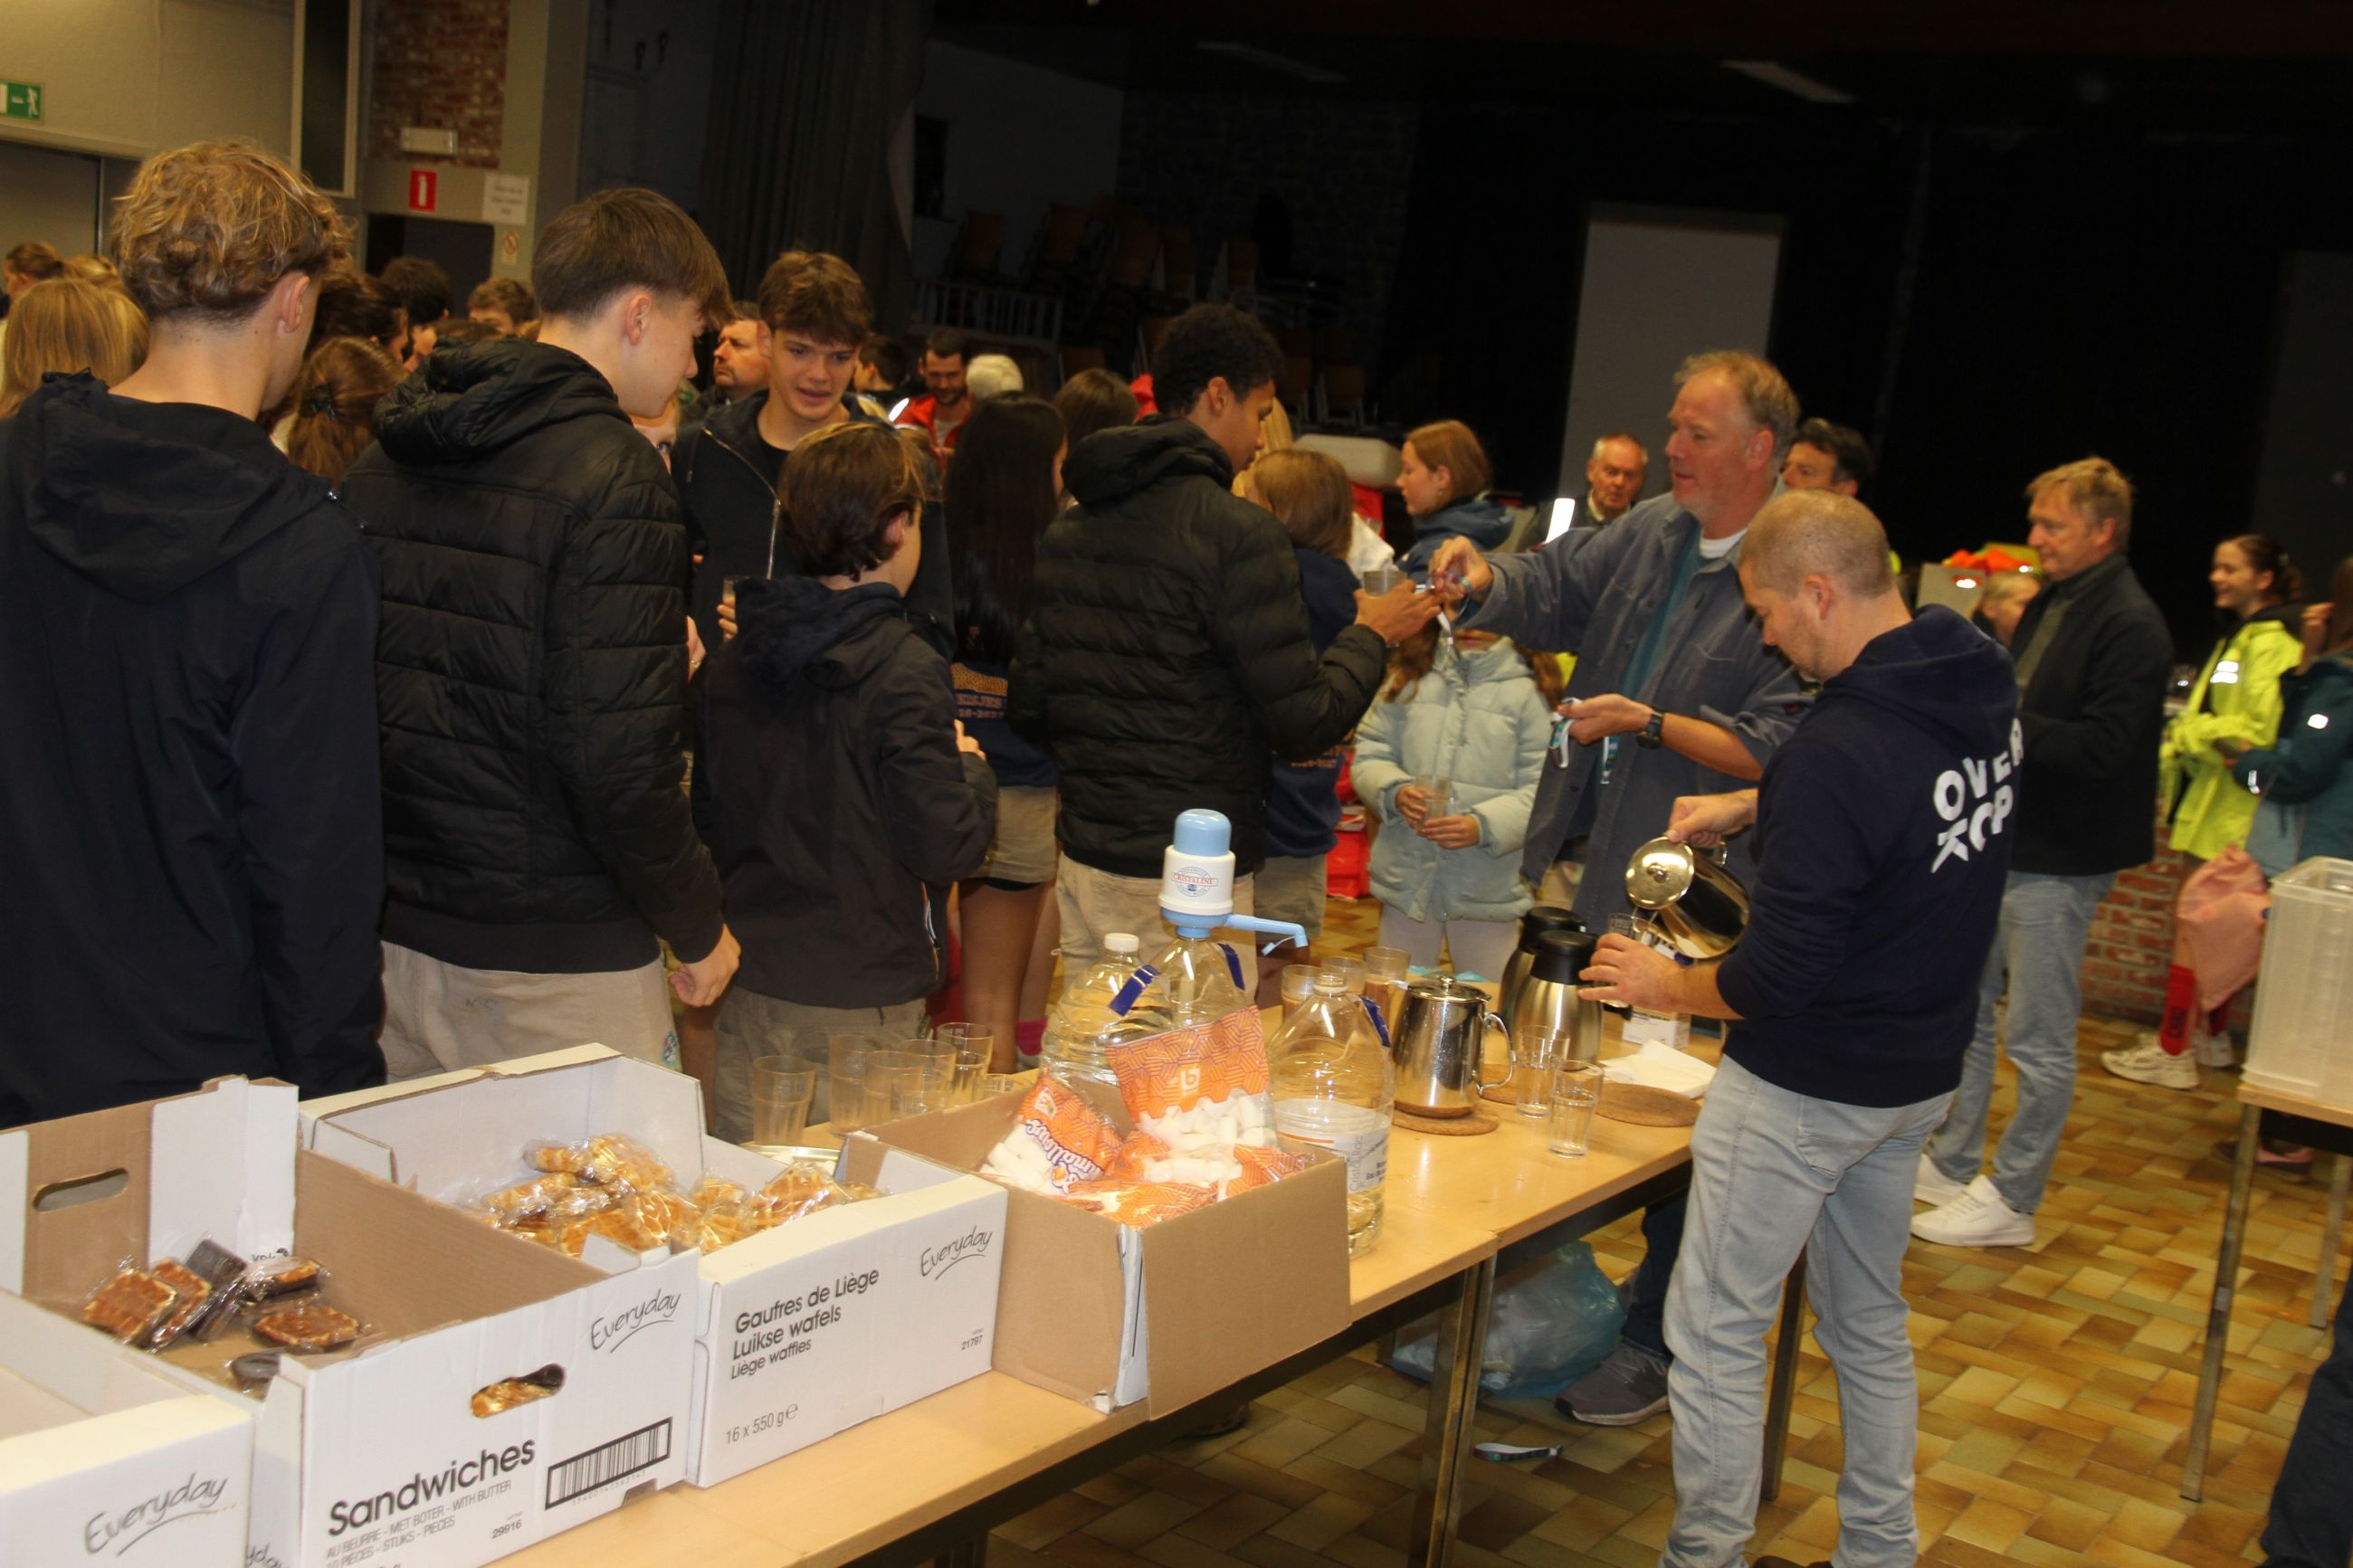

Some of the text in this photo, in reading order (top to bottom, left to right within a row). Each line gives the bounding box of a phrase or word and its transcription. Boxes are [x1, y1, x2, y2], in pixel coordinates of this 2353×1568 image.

[920, 1225, 994, 1278] Everyday
[591, 1288, 681, 1350] Everyday
[735, 1269, 880, 1334] Gaufres de Liège
[731, 1338, 812, 1380] Liège waffles
[732, 1305, 842, 1361] Luikse wafels
[961, 1335, 984, 1351] 21797
[725, 1425, 740, 1444] 16
[742, 1423, 750, 1438] x
[752, 1412, 775, 1435] 550
[84, 1472, 229, 1554] Everyday
[329, 1440, 536, 1536] Sandwiches
[327, 1479, 512, 1559] AU BEURRE MET BOTER WITH BUTTER
[383, 1532, 416, 1553] STUKS
[424, 1515, 456, 1537] PIECES
[491, 1519, 522, 1540] 29916
